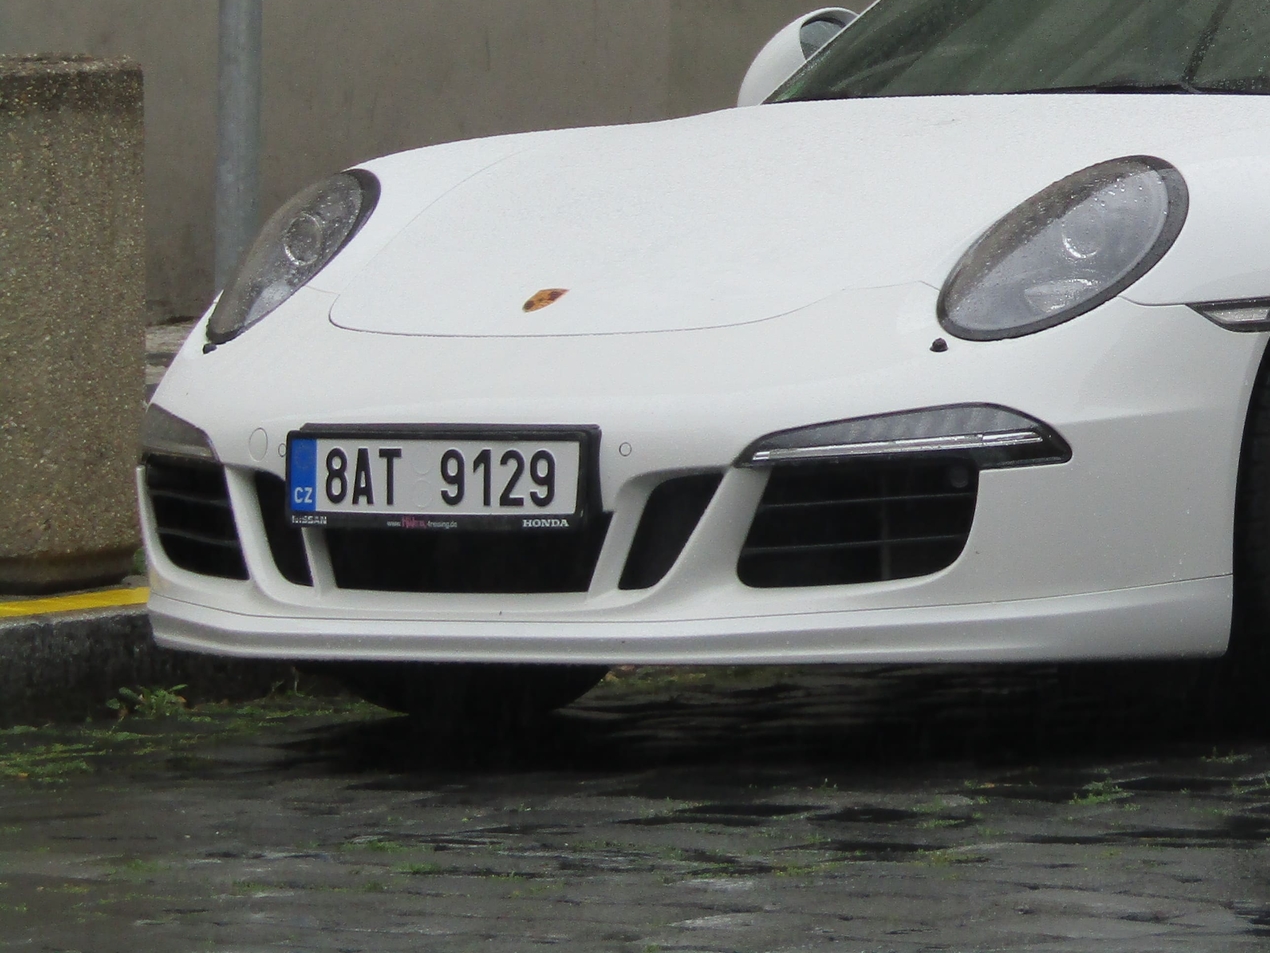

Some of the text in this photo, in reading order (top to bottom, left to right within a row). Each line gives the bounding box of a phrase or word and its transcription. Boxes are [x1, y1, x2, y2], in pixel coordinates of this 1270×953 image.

[326, 448, 555, 506] 8AT 9129
[294, 487, 312, 503] CZ
[522, 519, 569, 527] HONDA
